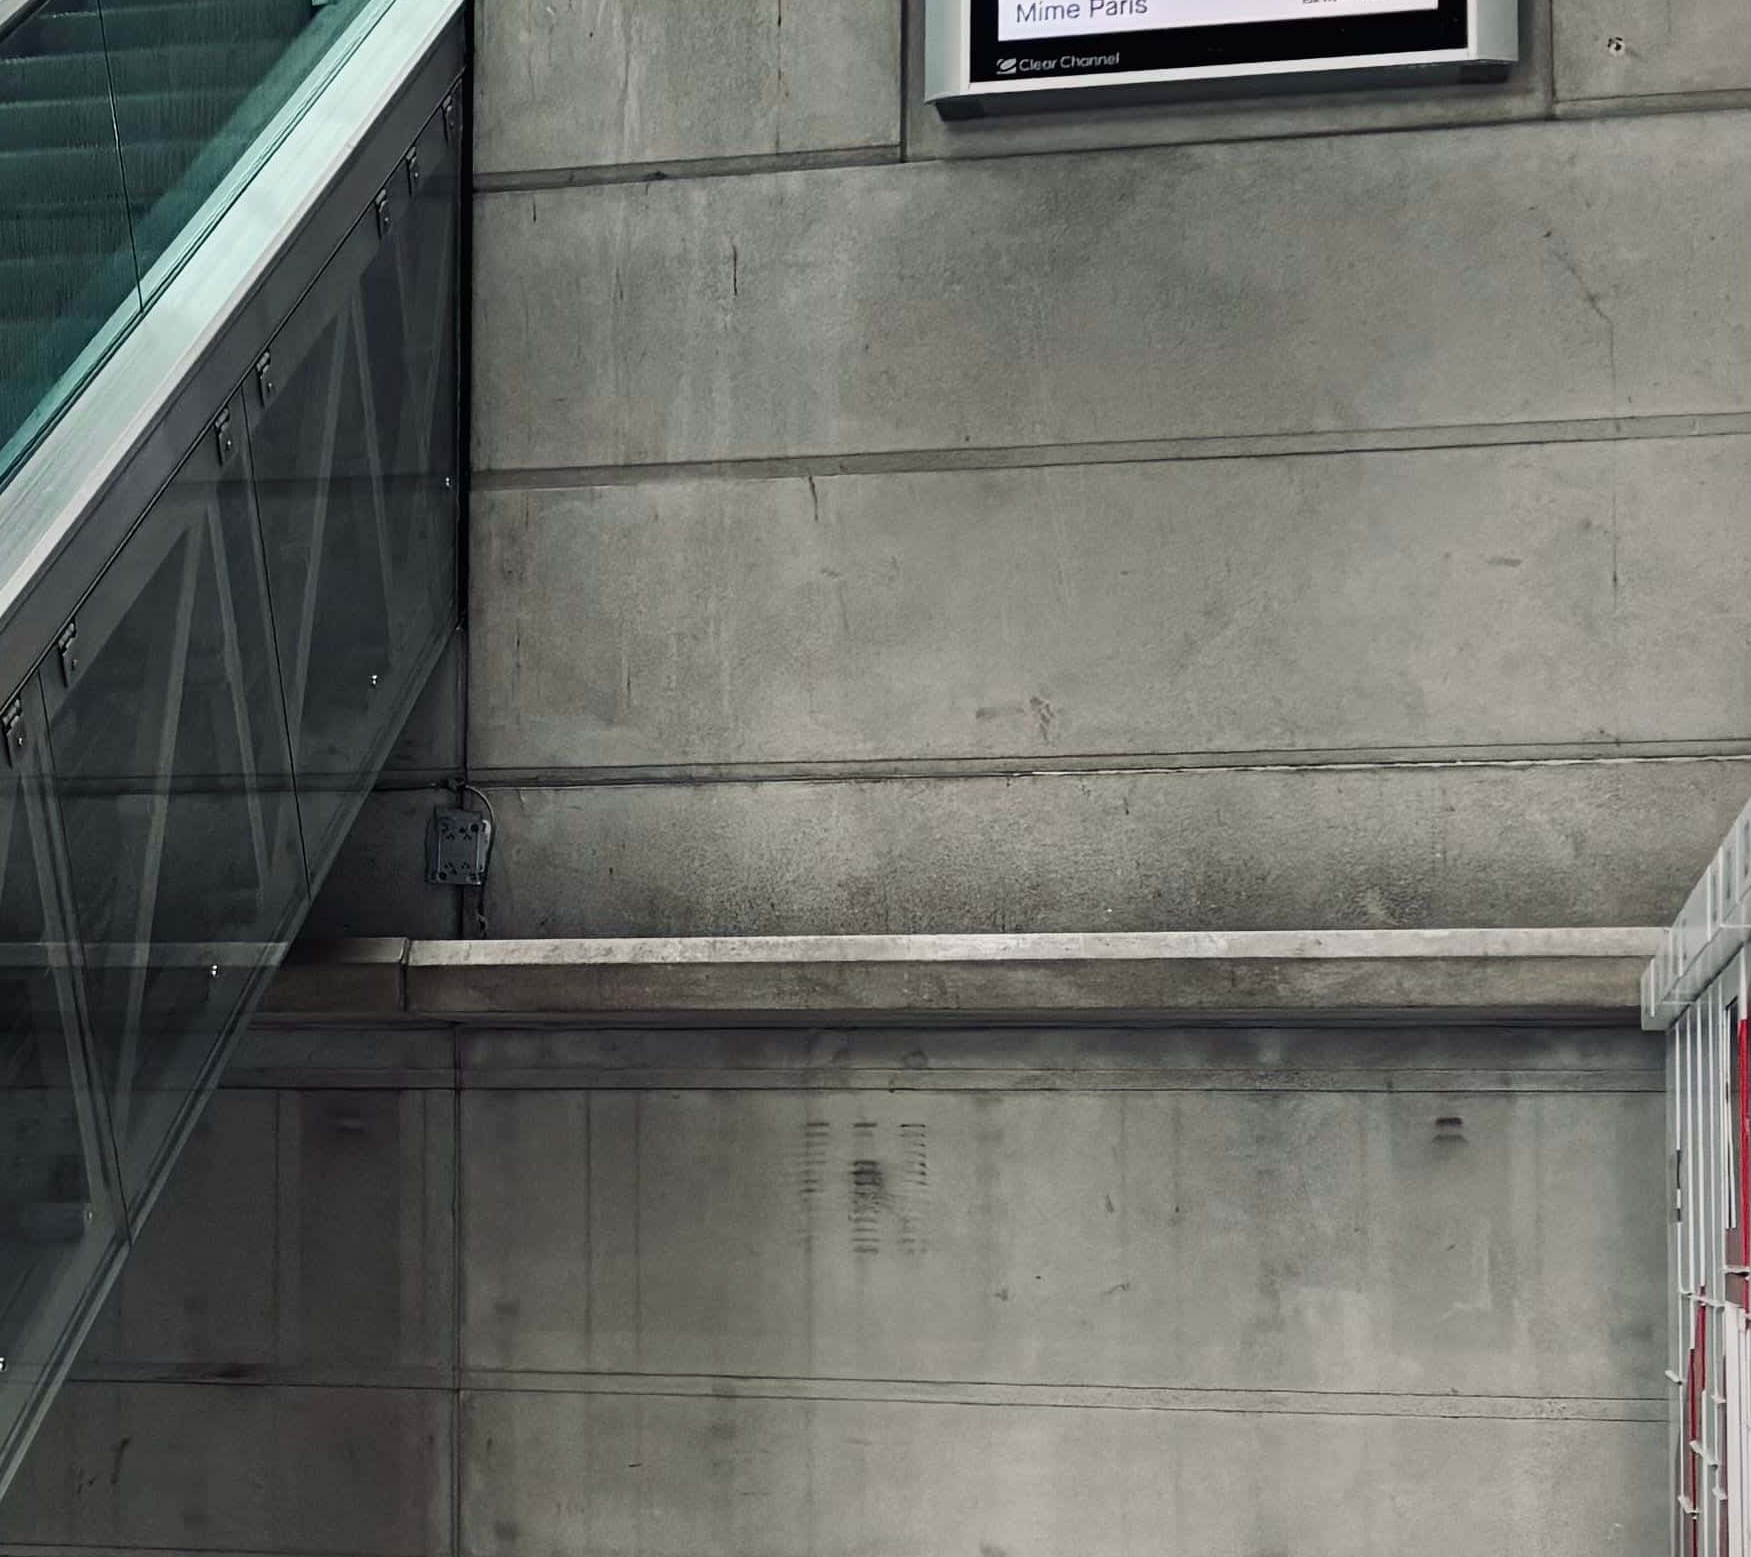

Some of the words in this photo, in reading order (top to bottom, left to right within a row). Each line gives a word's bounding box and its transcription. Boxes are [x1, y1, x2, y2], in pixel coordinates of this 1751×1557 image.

[1016, 0, 1081, 23] Mime
[1018, 57, 1058, 72] Clear
[1060, 52, 1121, 69] Channel
